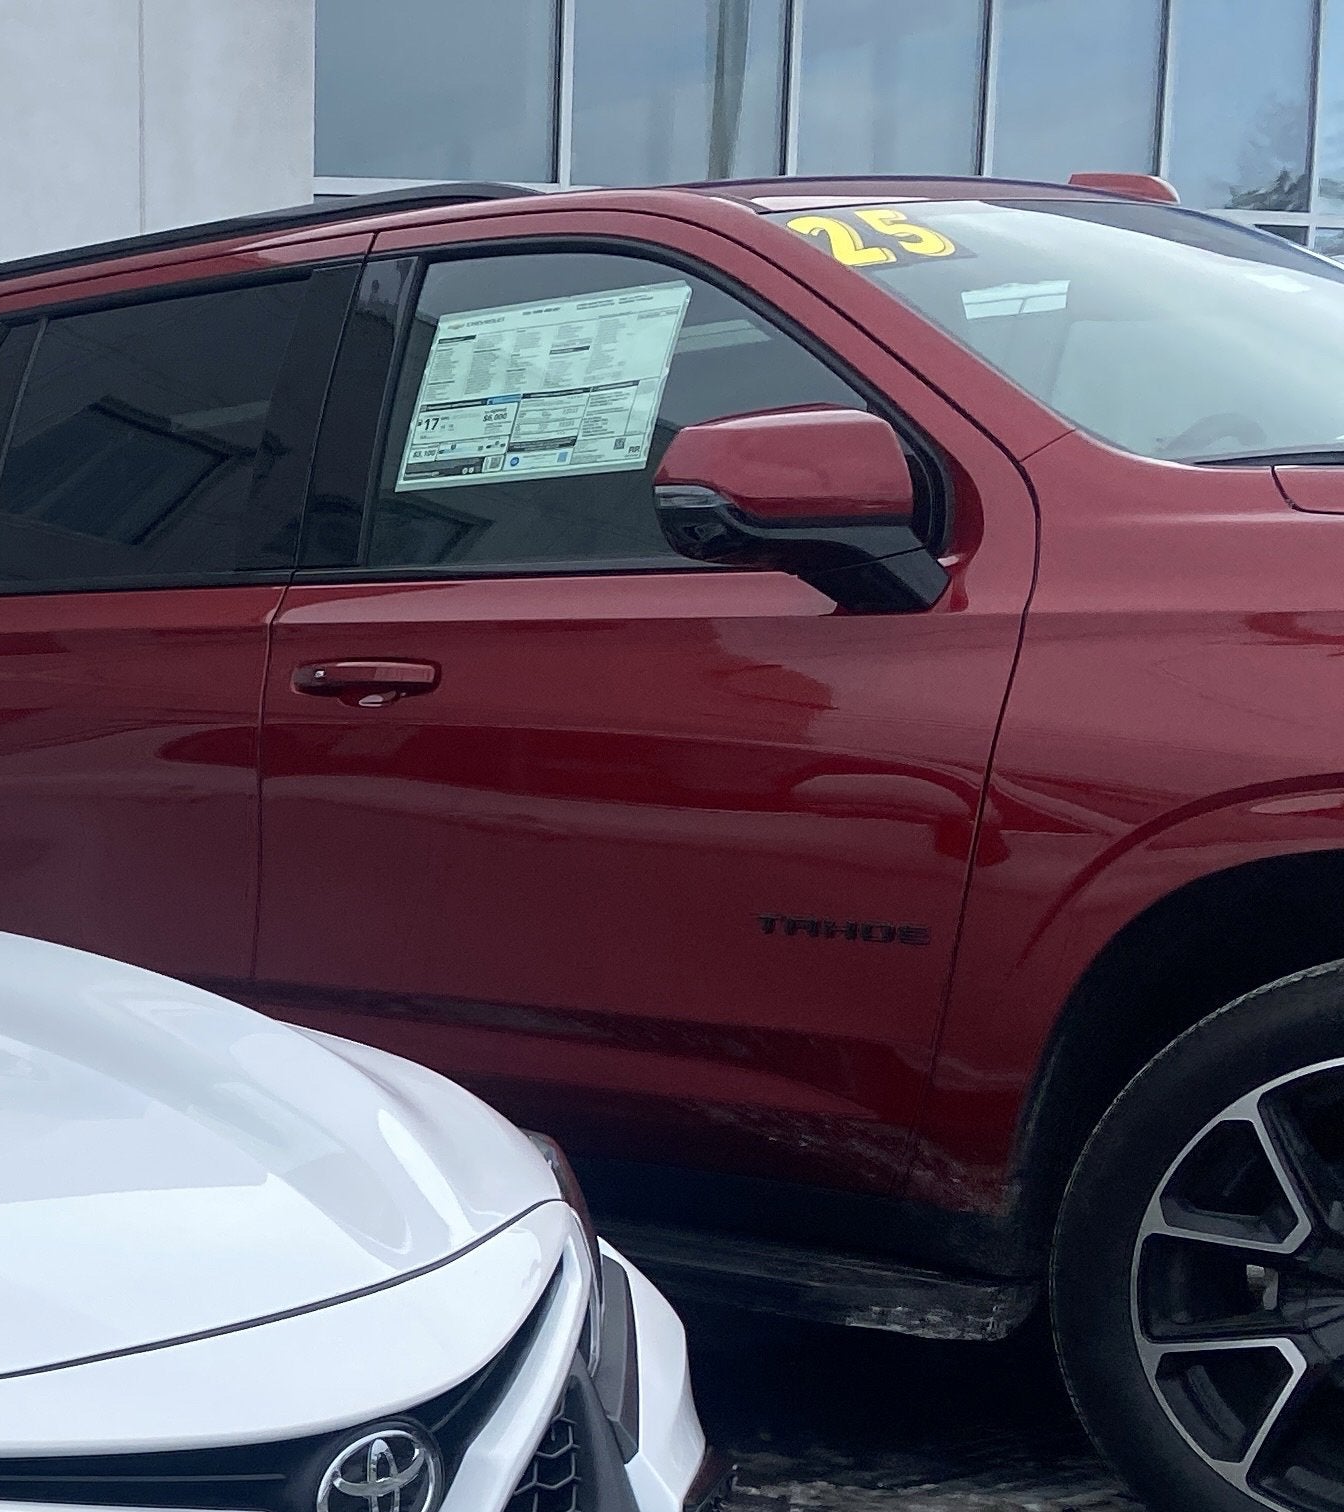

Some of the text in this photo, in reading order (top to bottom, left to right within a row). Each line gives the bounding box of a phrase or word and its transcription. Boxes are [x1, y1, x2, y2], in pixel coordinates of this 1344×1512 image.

[786, 209, 956, 266] 25
[424, 417, 439, 430] 17
[757, 911, 931, 946] TAHOE
